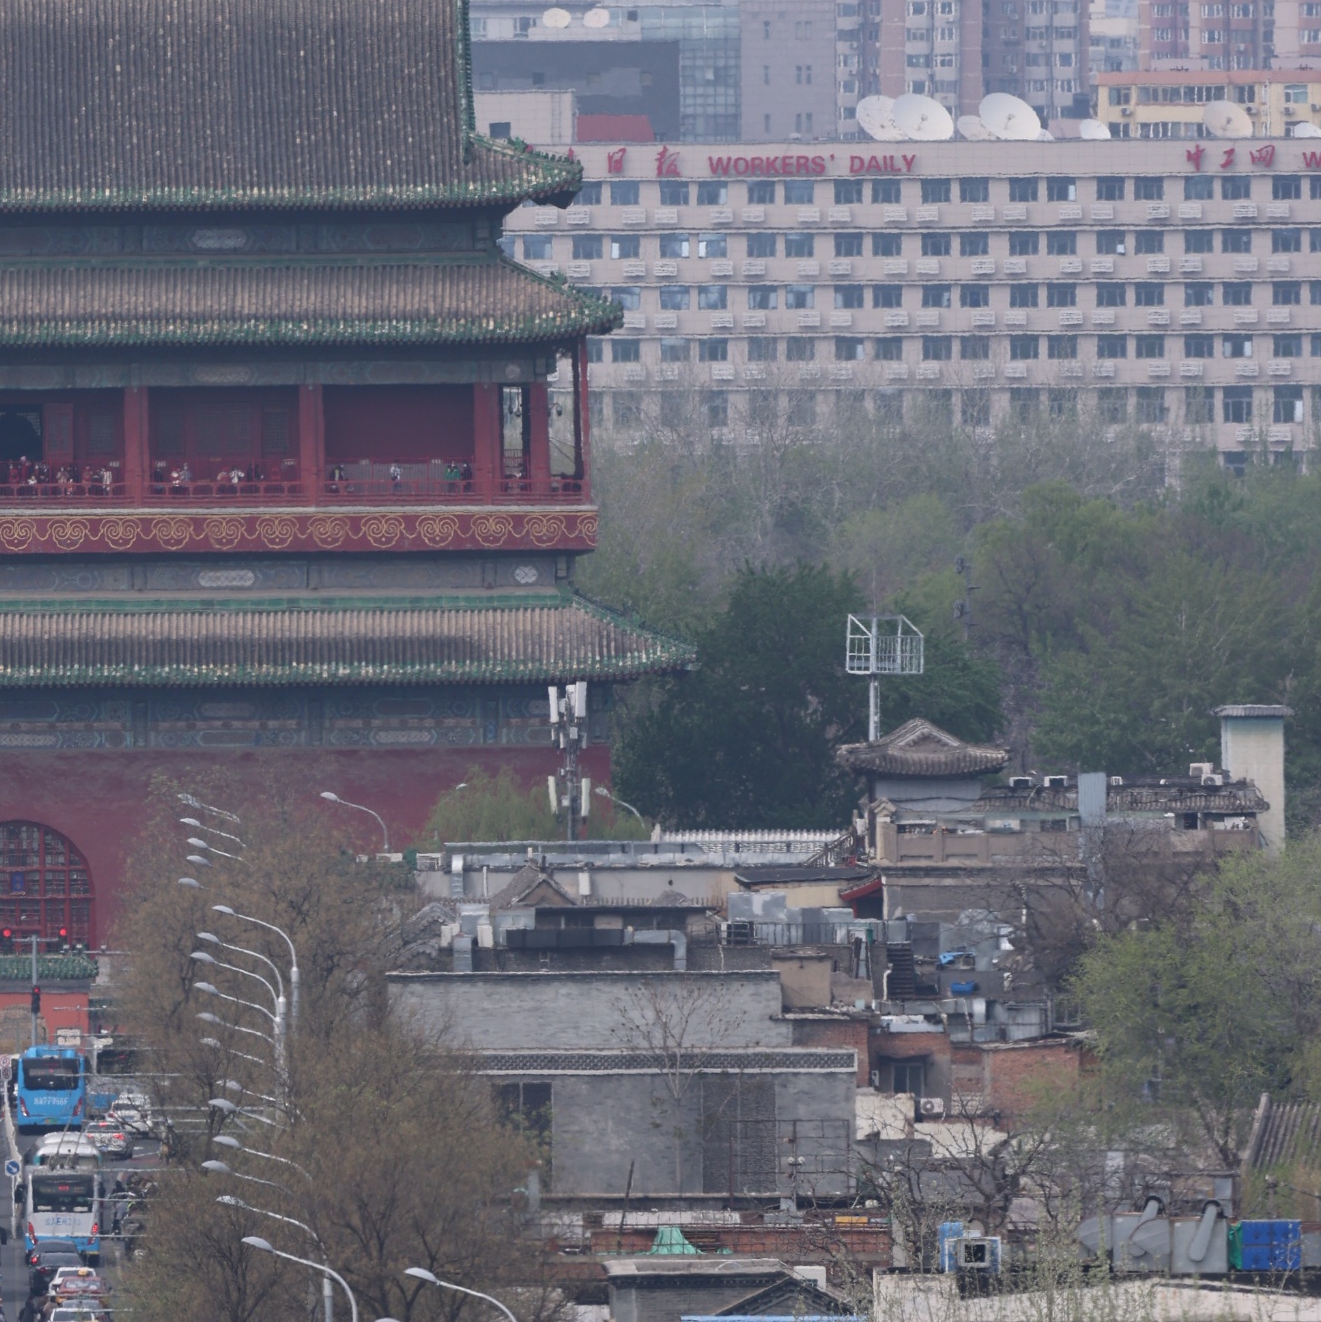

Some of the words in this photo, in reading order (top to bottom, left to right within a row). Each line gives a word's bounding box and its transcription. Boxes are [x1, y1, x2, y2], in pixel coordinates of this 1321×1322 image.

[708, 153, 836, 176] WORKERS'
[849, 154, 916, 174] DAILY
[1186, 144, 1276, 173] 中工网
